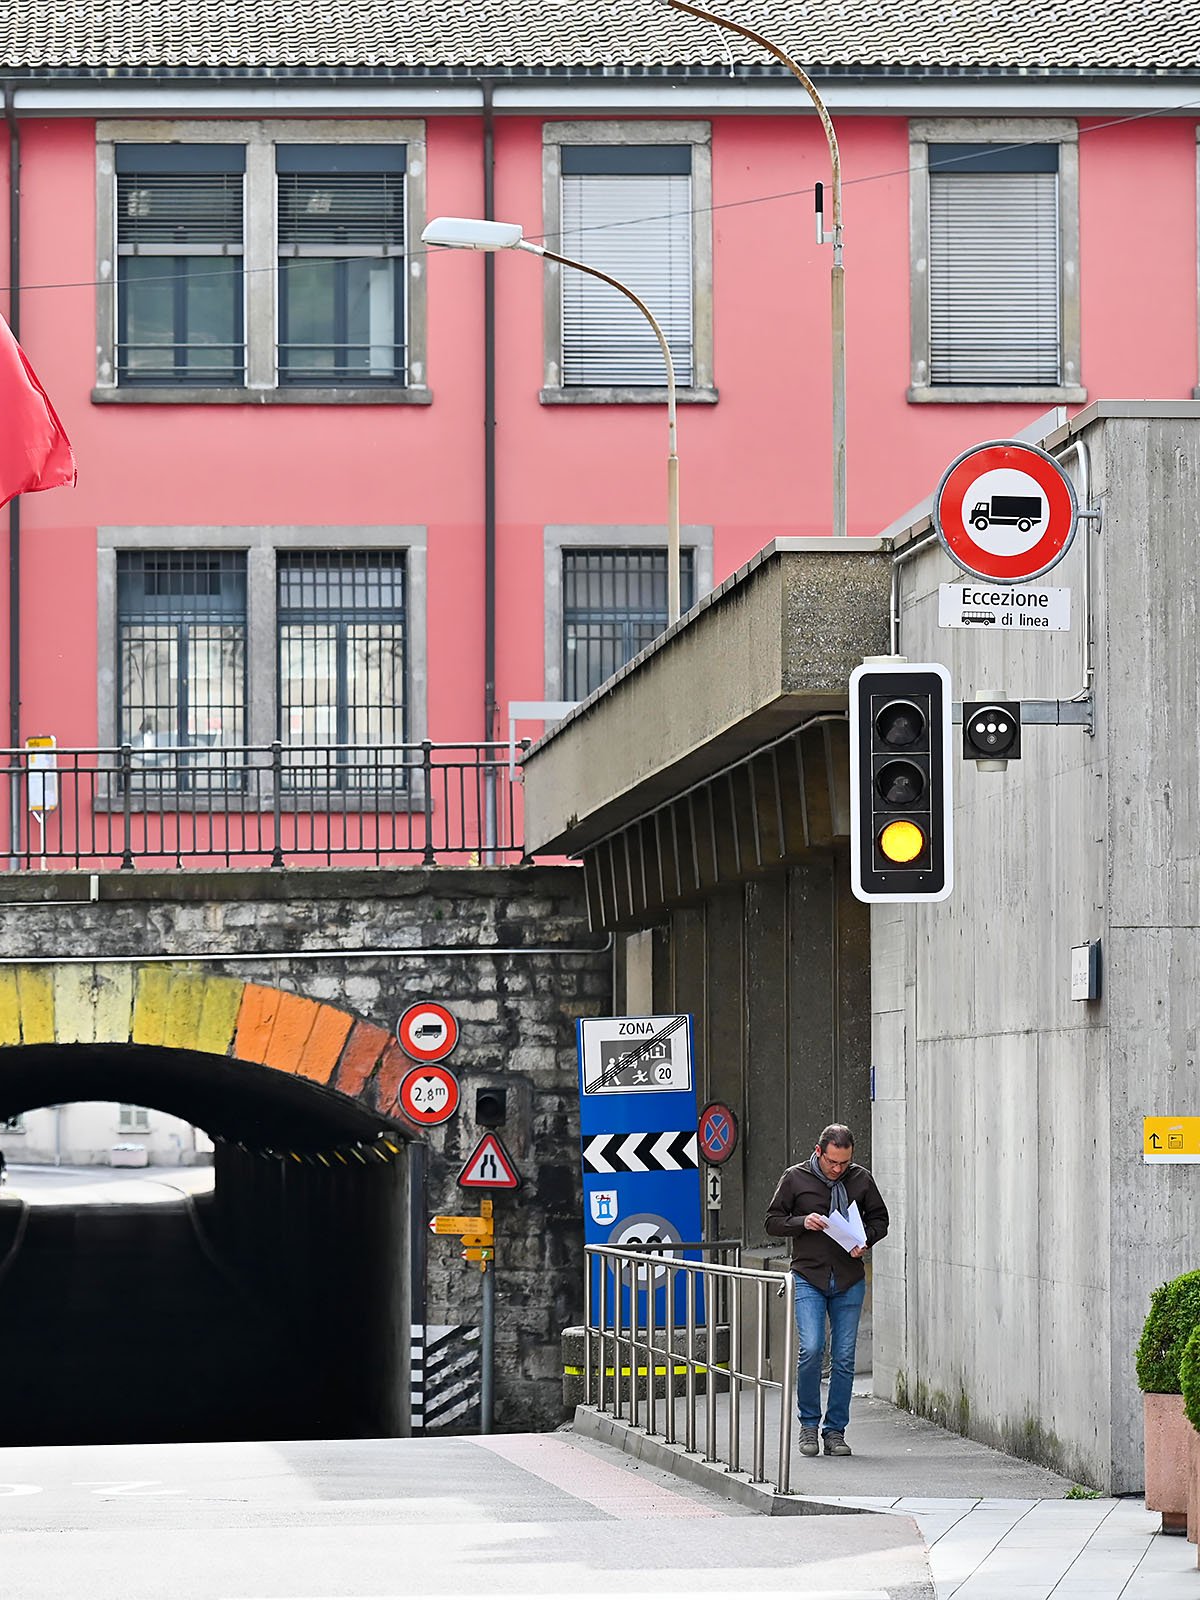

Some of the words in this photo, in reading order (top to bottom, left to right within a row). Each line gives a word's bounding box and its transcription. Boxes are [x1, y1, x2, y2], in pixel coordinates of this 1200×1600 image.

[962, 588, 1049, 607] Eccezione
[1001, 613, 1013, 625] di
[1019, 613, 1049, 626] linea
[619, 1023, 655, 1035] ZONA
[658, 1068, 672, 1080] 20
[481, 1250, 489, 1259] 7
